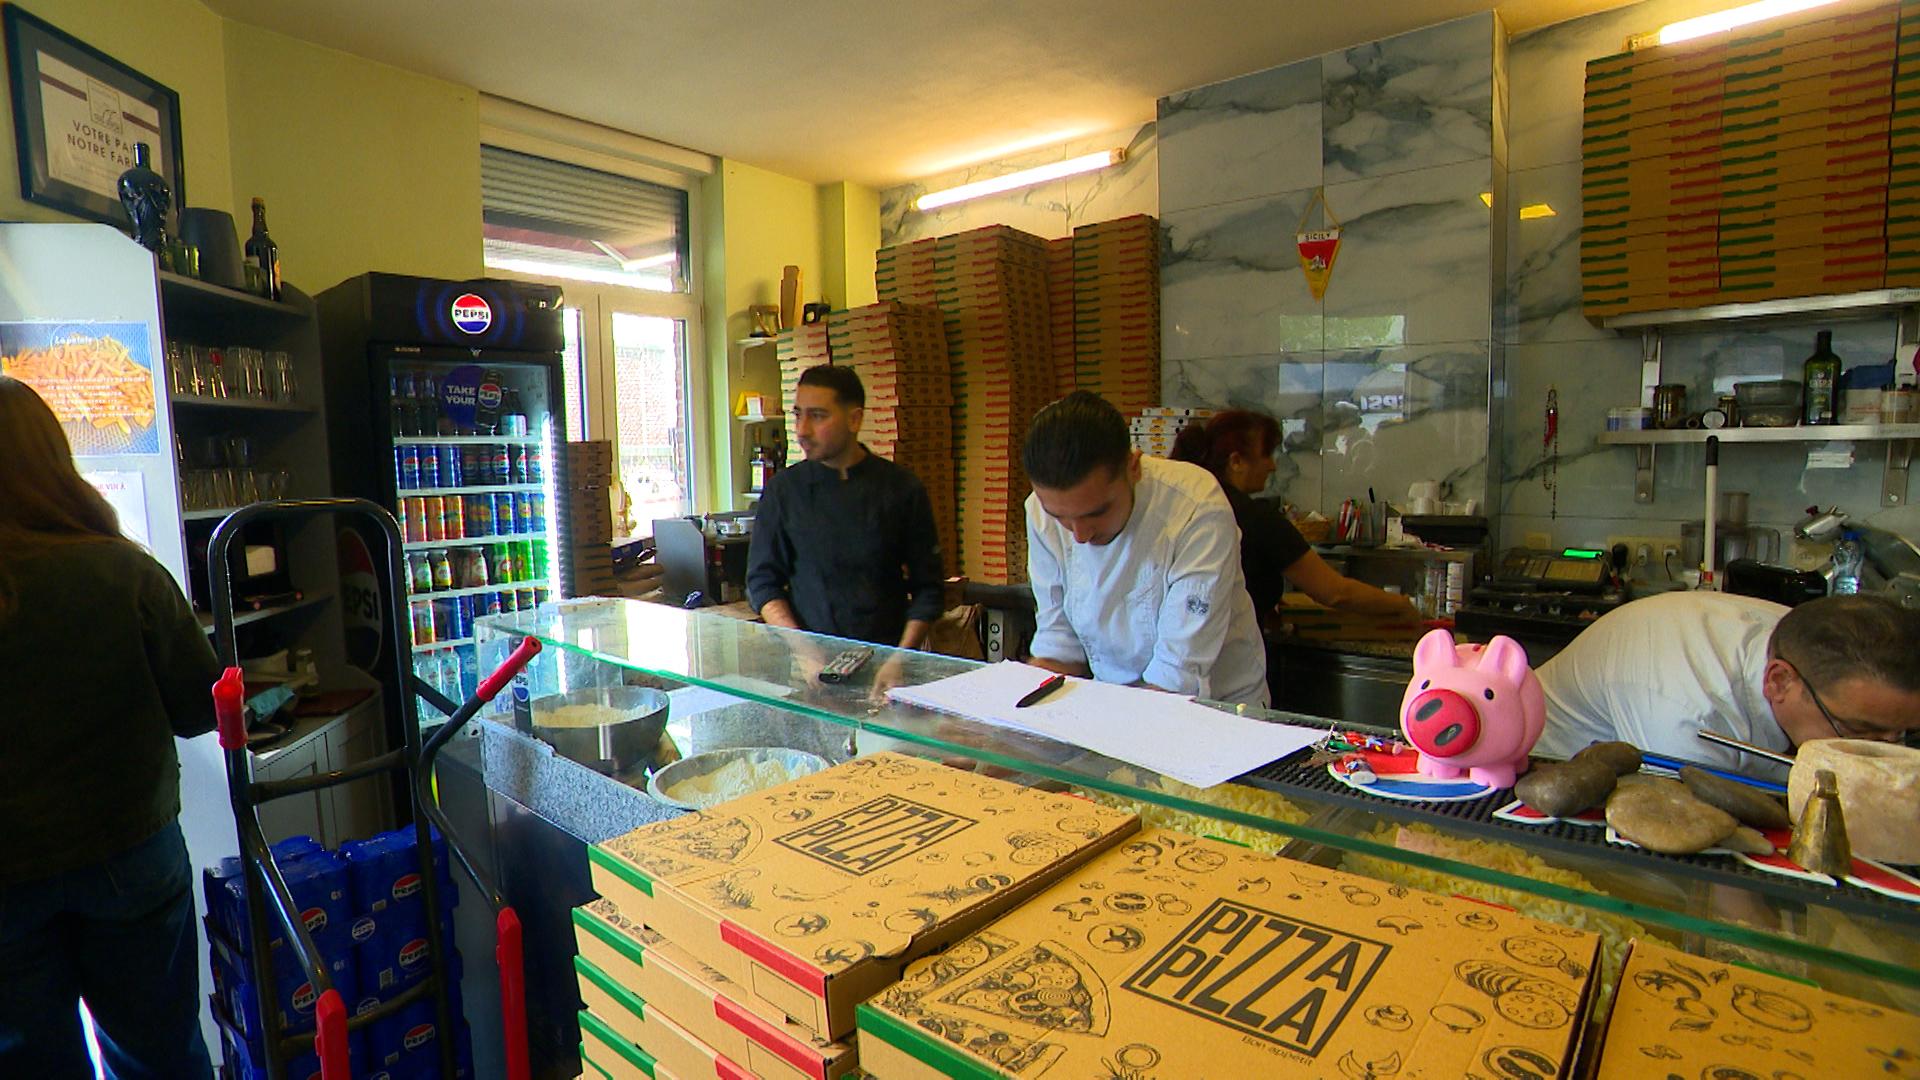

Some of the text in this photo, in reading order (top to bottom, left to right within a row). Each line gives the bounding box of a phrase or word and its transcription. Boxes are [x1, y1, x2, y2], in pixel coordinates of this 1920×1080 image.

[73, 120, 110, 146] VOTRE
[67, 133, 105, 158] NOTRE
[1304, 233, 1330, 241] SICILY
[455, 309, 489, 320] PEPSI
[446, 385, 475, 396] TAKE
[445, 395, 475, 406] YOUR
